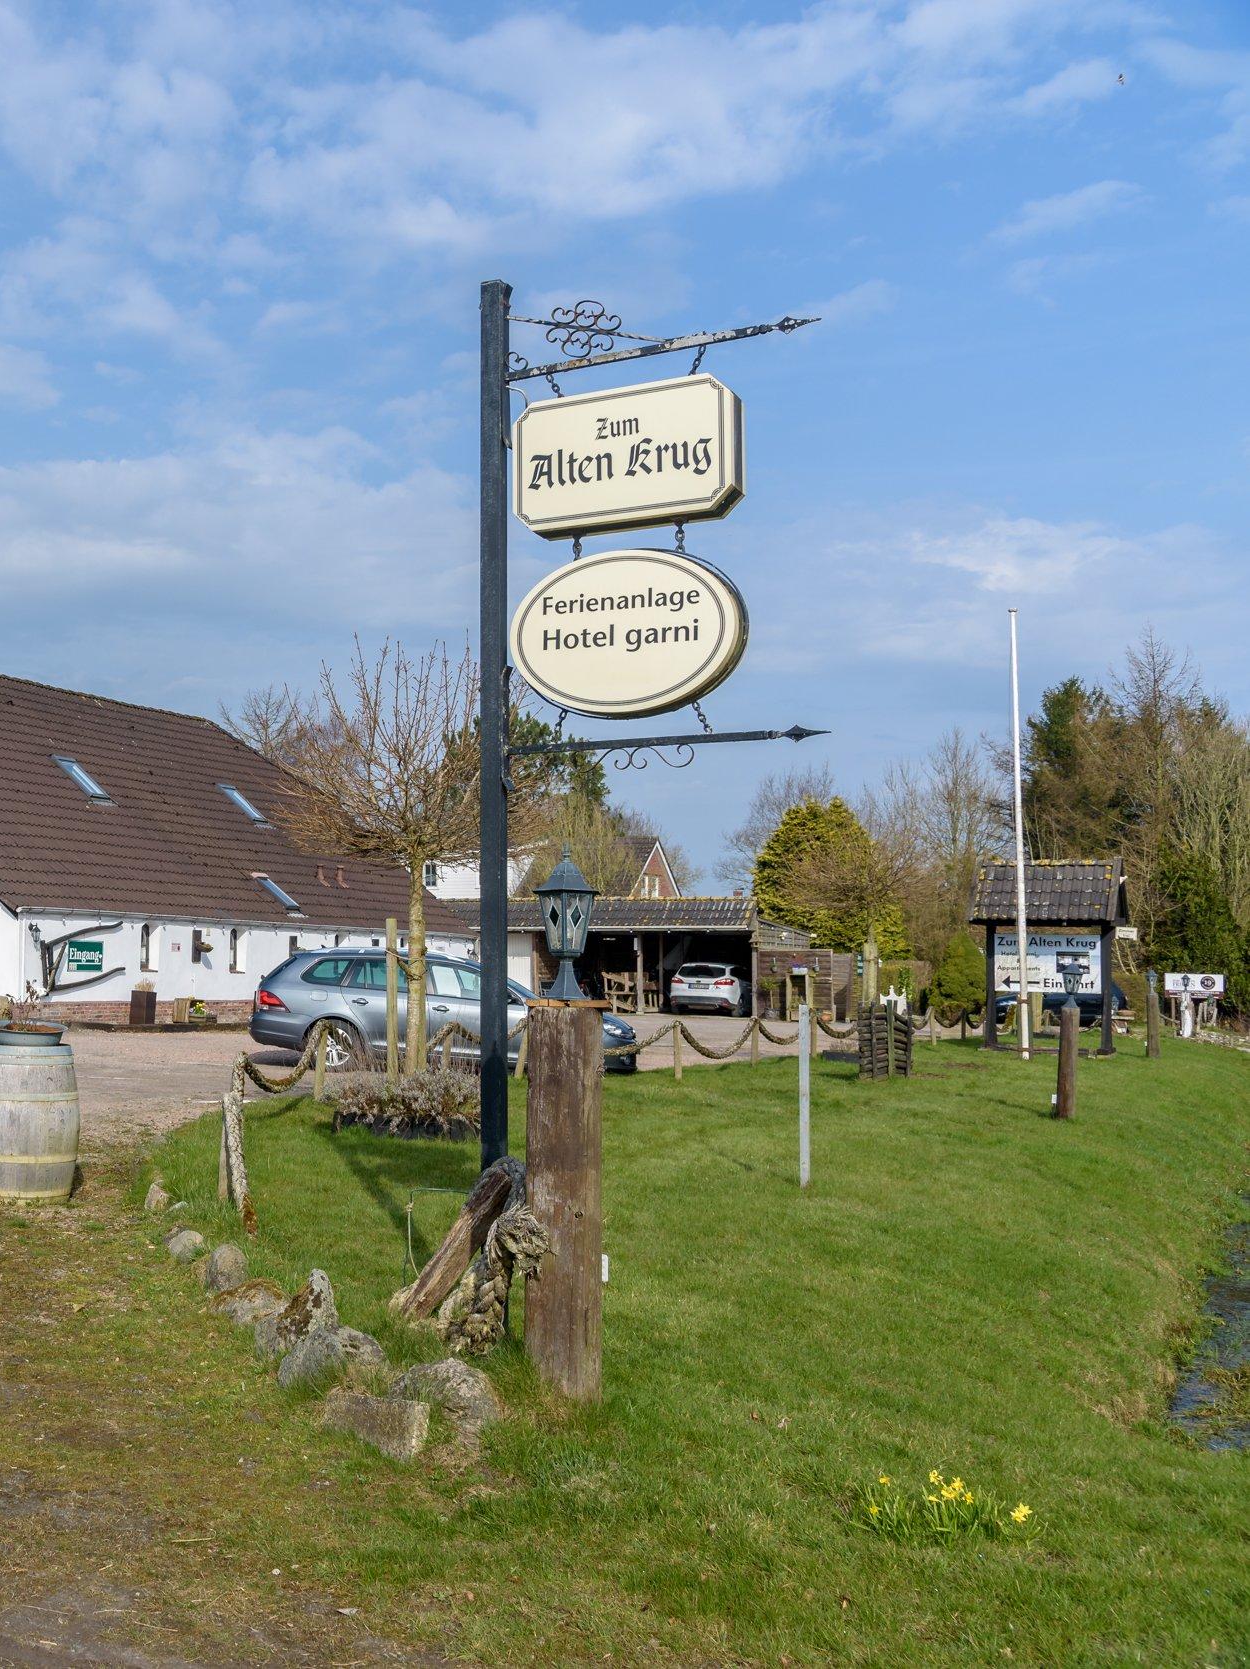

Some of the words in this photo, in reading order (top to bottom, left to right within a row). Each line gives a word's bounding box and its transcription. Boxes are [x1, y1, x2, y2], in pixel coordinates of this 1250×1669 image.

[595, 416, 640, 441] Zum
[528, 449, 615, 491] Alten
[624, 437, 713, 477] Krug
[542, 587, 701, 616] Ferienanlage
[543, 624, 615, 651] Hotel
[625, 618, 699, 652] garni
[69, 947, 100, 963] Eingang
[1029, 937, 1061, 947] Alten
[1066, 937, 1097, 950] Krug
